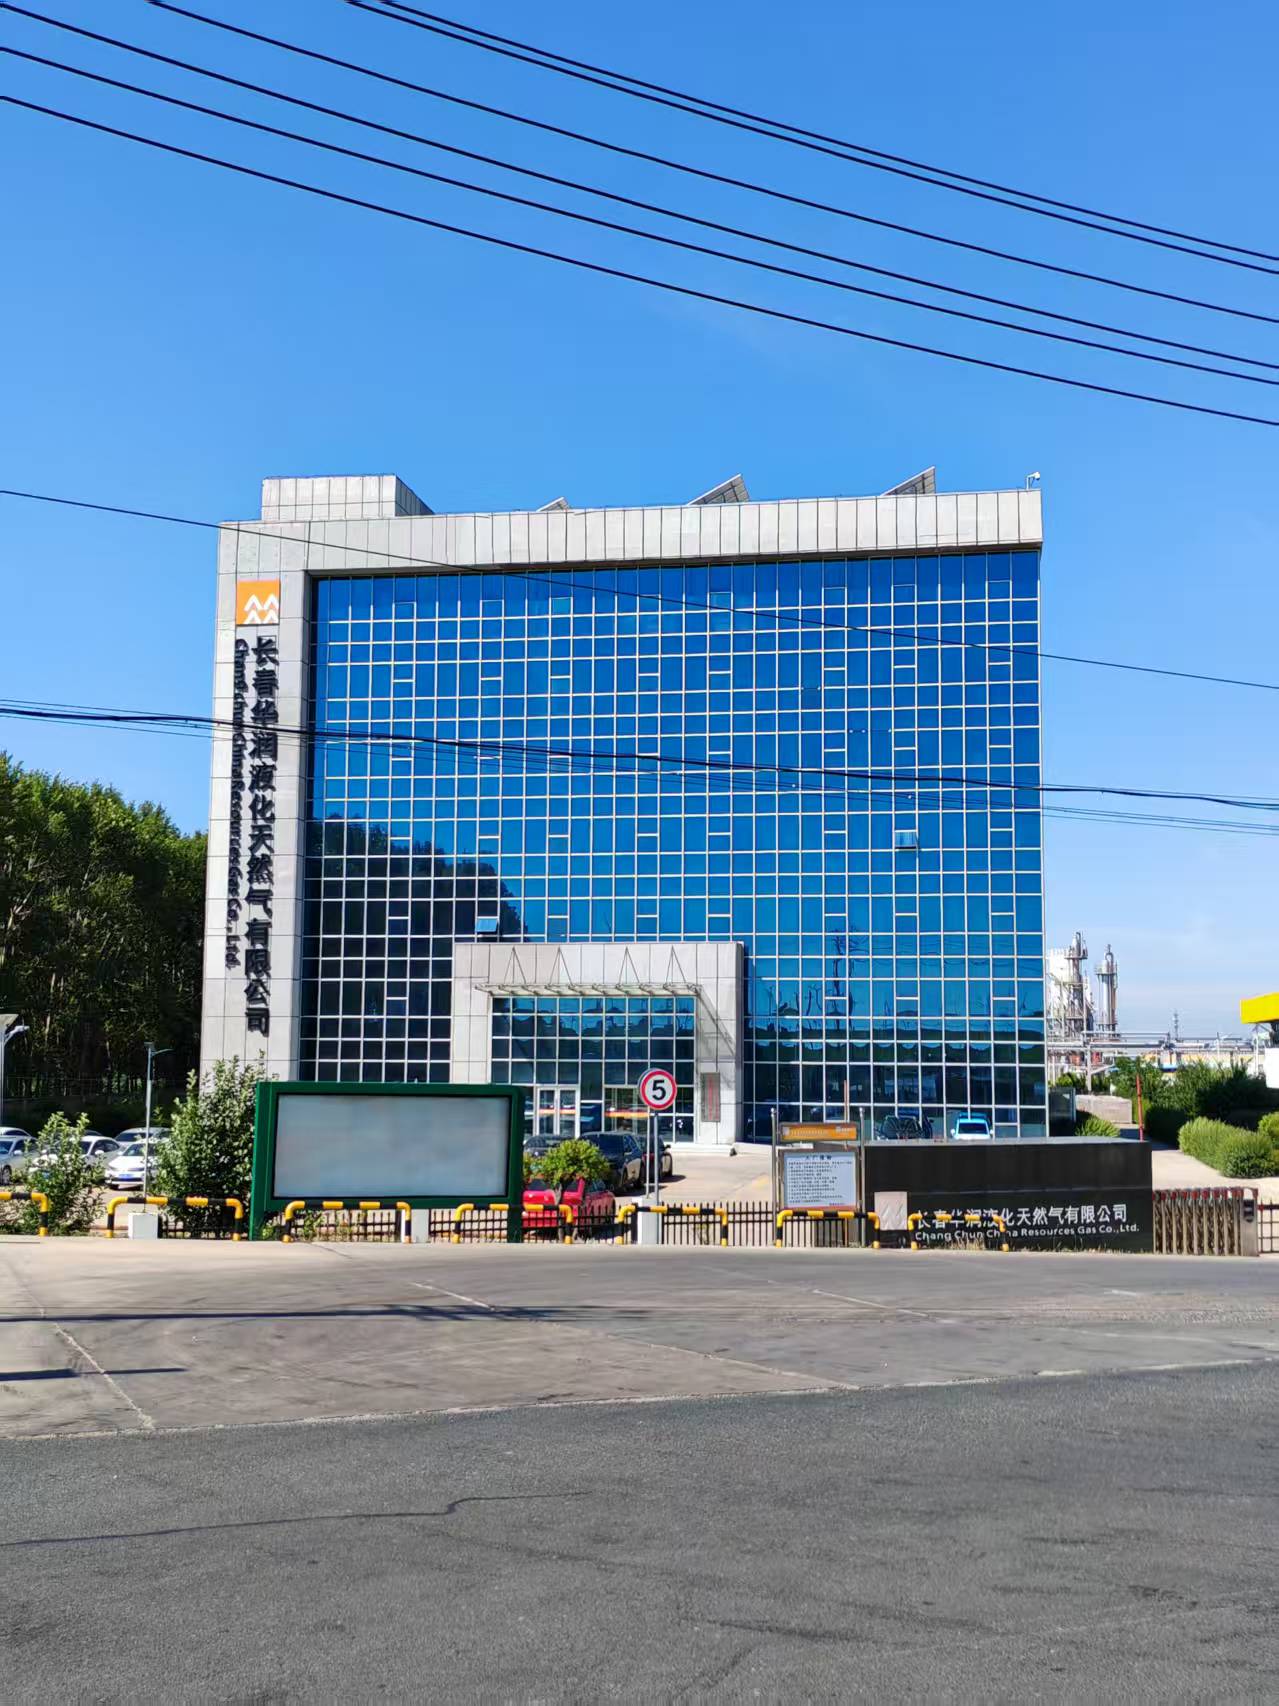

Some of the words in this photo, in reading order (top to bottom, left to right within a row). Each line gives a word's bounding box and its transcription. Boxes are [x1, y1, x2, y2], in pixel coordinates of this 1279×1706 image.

[244, 635, 279, 1038] 长春华润液化天然气有限公司
[652, 1079, 667, 1101] 5
[915, 1231, 951, 1241] Chang
[954, 1230, 984, 1239] Chun
[986, 1228, 1018, 1238] Chna
[1021, 1227, 1075, 1237] Resources
[1077, 1225, 1097, 1234] Gas
